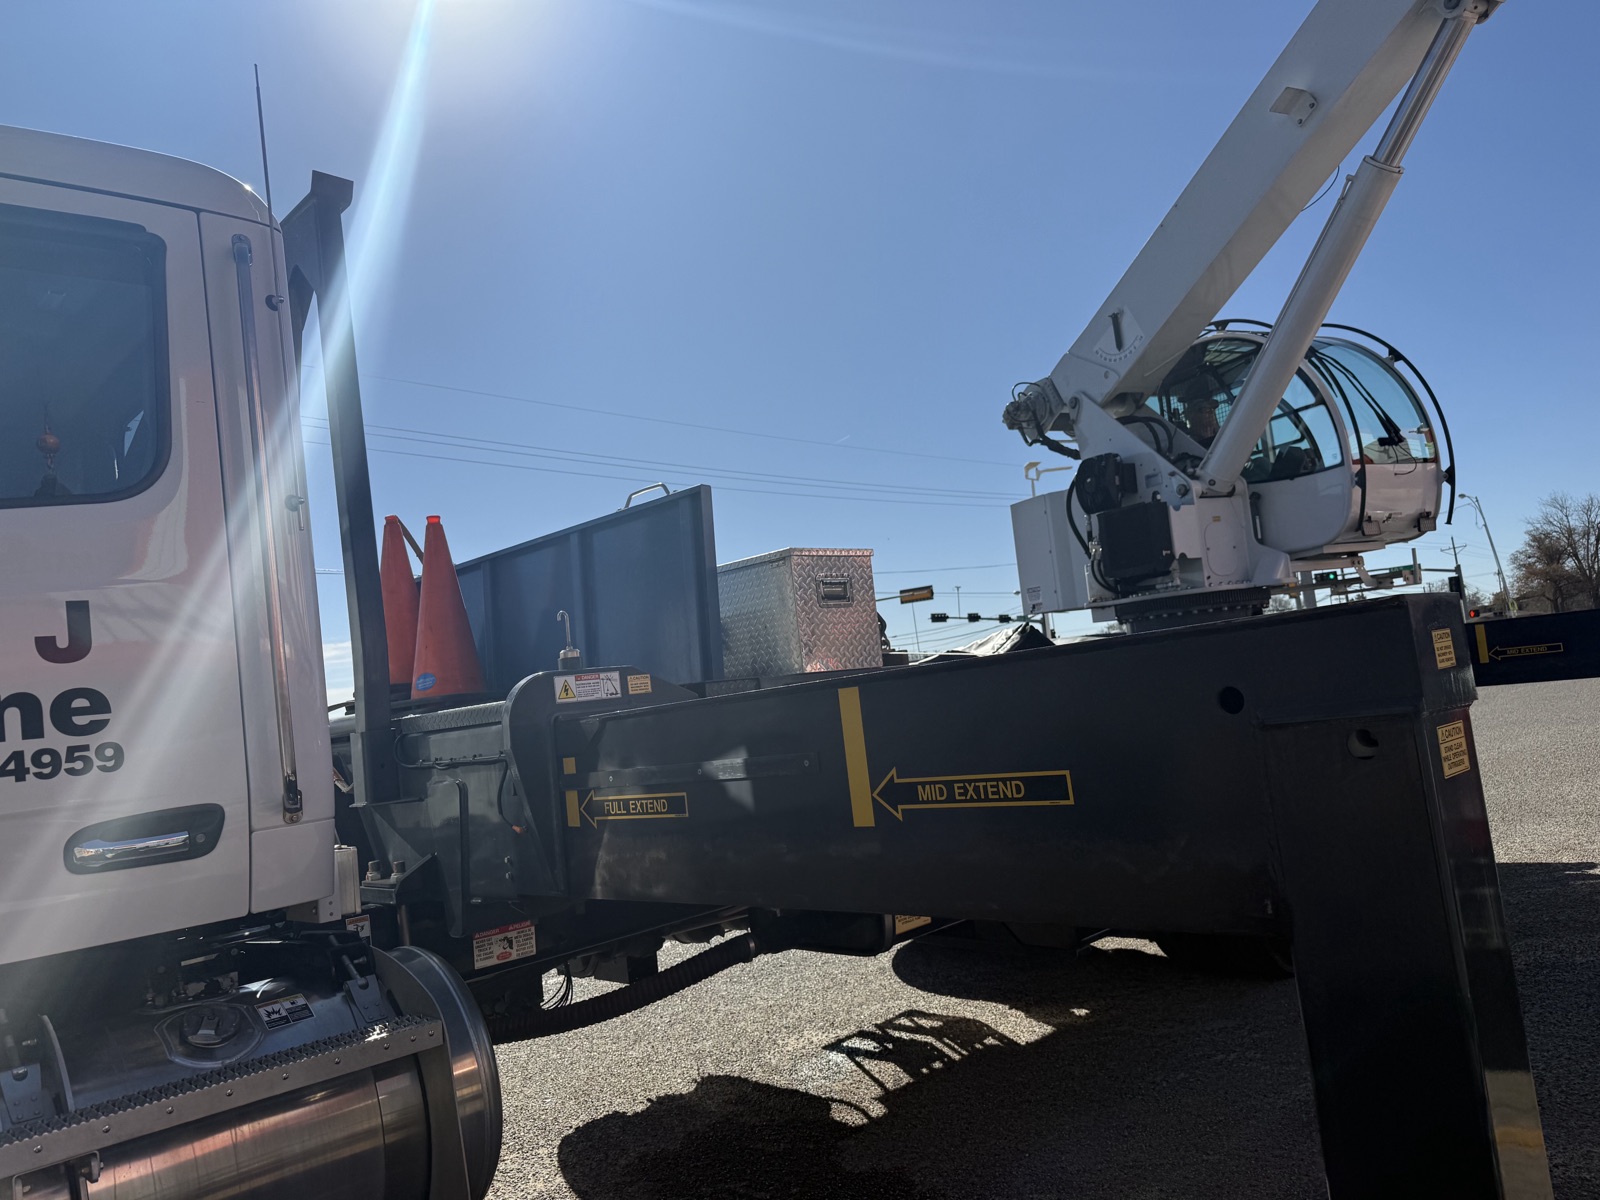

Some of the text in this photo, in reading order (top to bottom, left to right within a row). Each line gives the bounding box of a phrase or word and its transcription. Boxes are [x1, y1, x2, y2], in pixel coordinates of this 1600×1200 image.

[34, 600, 92, 664] J
[1445, 726, 1462, 739] CAUTION
[0, 741, 125, 783] 4959
[917, 780, 1025, 801] MID EXTEND
[604, 799, 668, 814] FULL EXTEND
[480, 928, 500, 937] DANGER
